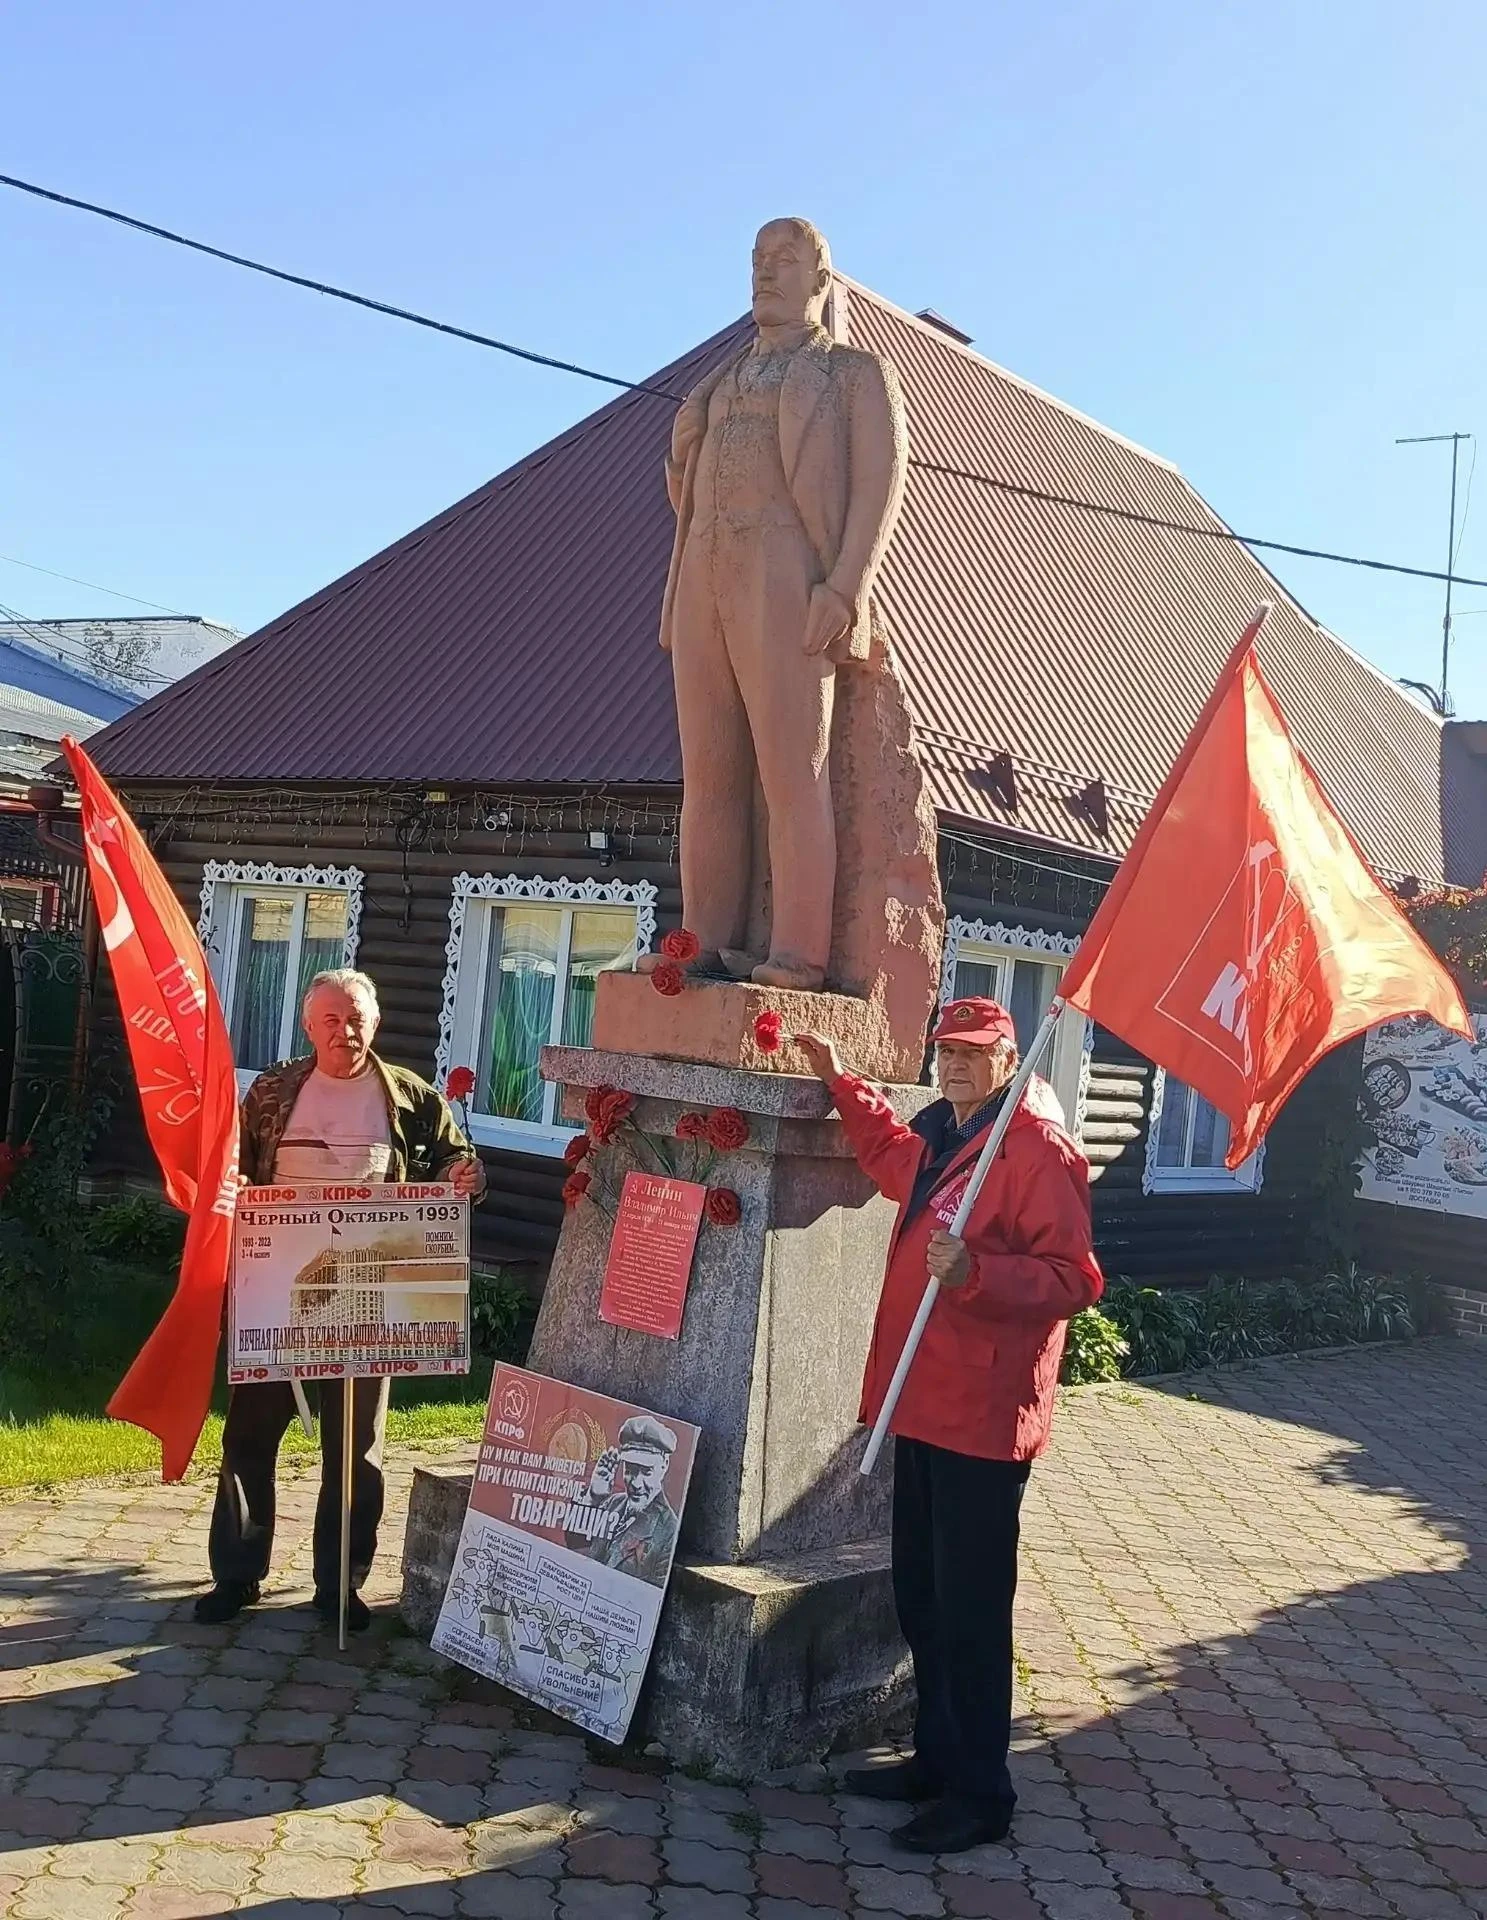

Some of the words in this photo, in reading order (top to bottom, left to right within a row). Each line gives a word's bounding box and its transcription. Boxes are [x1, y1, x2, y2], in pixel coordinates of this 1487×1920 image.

[247, 1188, 297, 1202] КПРФ
[323, 1186, 372, 1201] КПРФ
[397, 1185, 445, 1200] КПРФ
[641, 1181, 683, 1202] Ленин
[1408, 1195, 1442, 1205] ДОСТАВКА
[415, 1206, 460, 1221] 1993
[623, 1195, 666, 1218] Владимир
[669, 1205, 698, 1222] Ильич
[242, 1237, 254, 1248] 1993
[238, 1328, 271, 1352] ВЕЧНАЯ
[272, 1326, 305, 1350] ПАМЯТЬ
[392, 1322, 420, 1345] ВЛАСТЬ
[294, 1364, 345, 1377] КПРФ
[370, 1361, 418, 1373] КПРФ
[494, 1419, 525, 1440] КПРФ
[482, 1444, 494, 1459] НУ
[495, 1446, 503, 1458] И
[503, 1448, 520, 1465] КАК
[521, 1453, 544, 1469] ВАМ
[543, 1455, 587, 1476] ЖИВЕТСЯ
[478, 1463, 501, 1485] ПРИ
[509, 1492, 620, 1542] ТОВАРИЩИ?
[485, 1532, 500, 1544] ЛАДА
[451, 1625, 484, 1647] СОГЛАСЕН
[546, 1665, 589, 1687] СПАСИБО
[590, 1680, 601, 1691] ЗА
